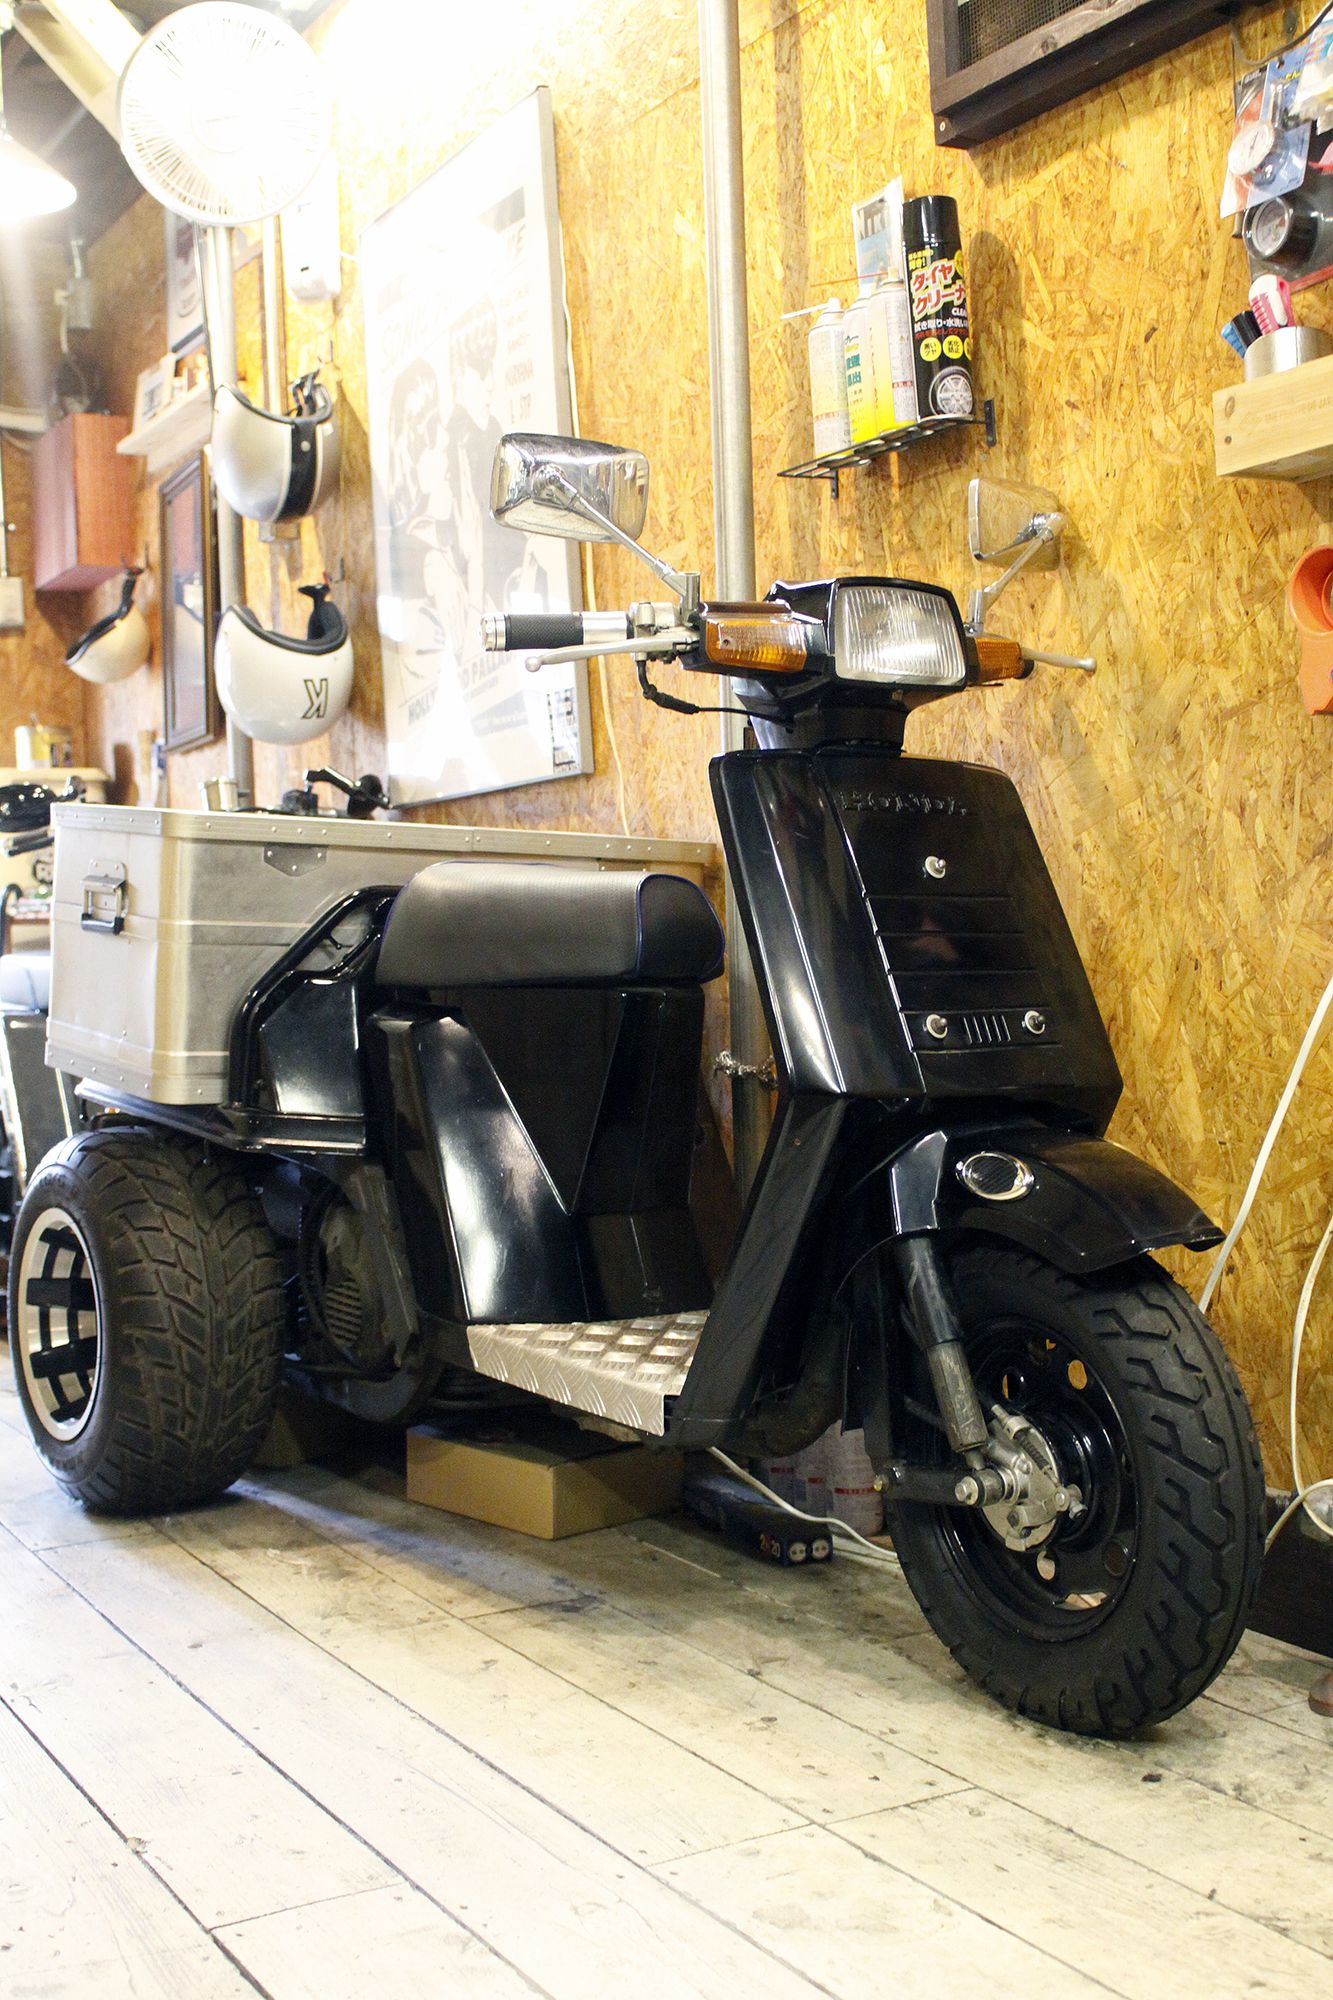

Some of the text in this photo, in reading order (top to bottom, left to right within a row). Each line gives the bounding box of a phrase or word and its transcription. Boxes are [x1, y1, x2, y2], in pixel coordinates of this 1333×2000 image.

[912, 262, 954, 294] タイヤ
[914, 282, 966, 317] クリーナ
[302, 678, 328, 719] K
